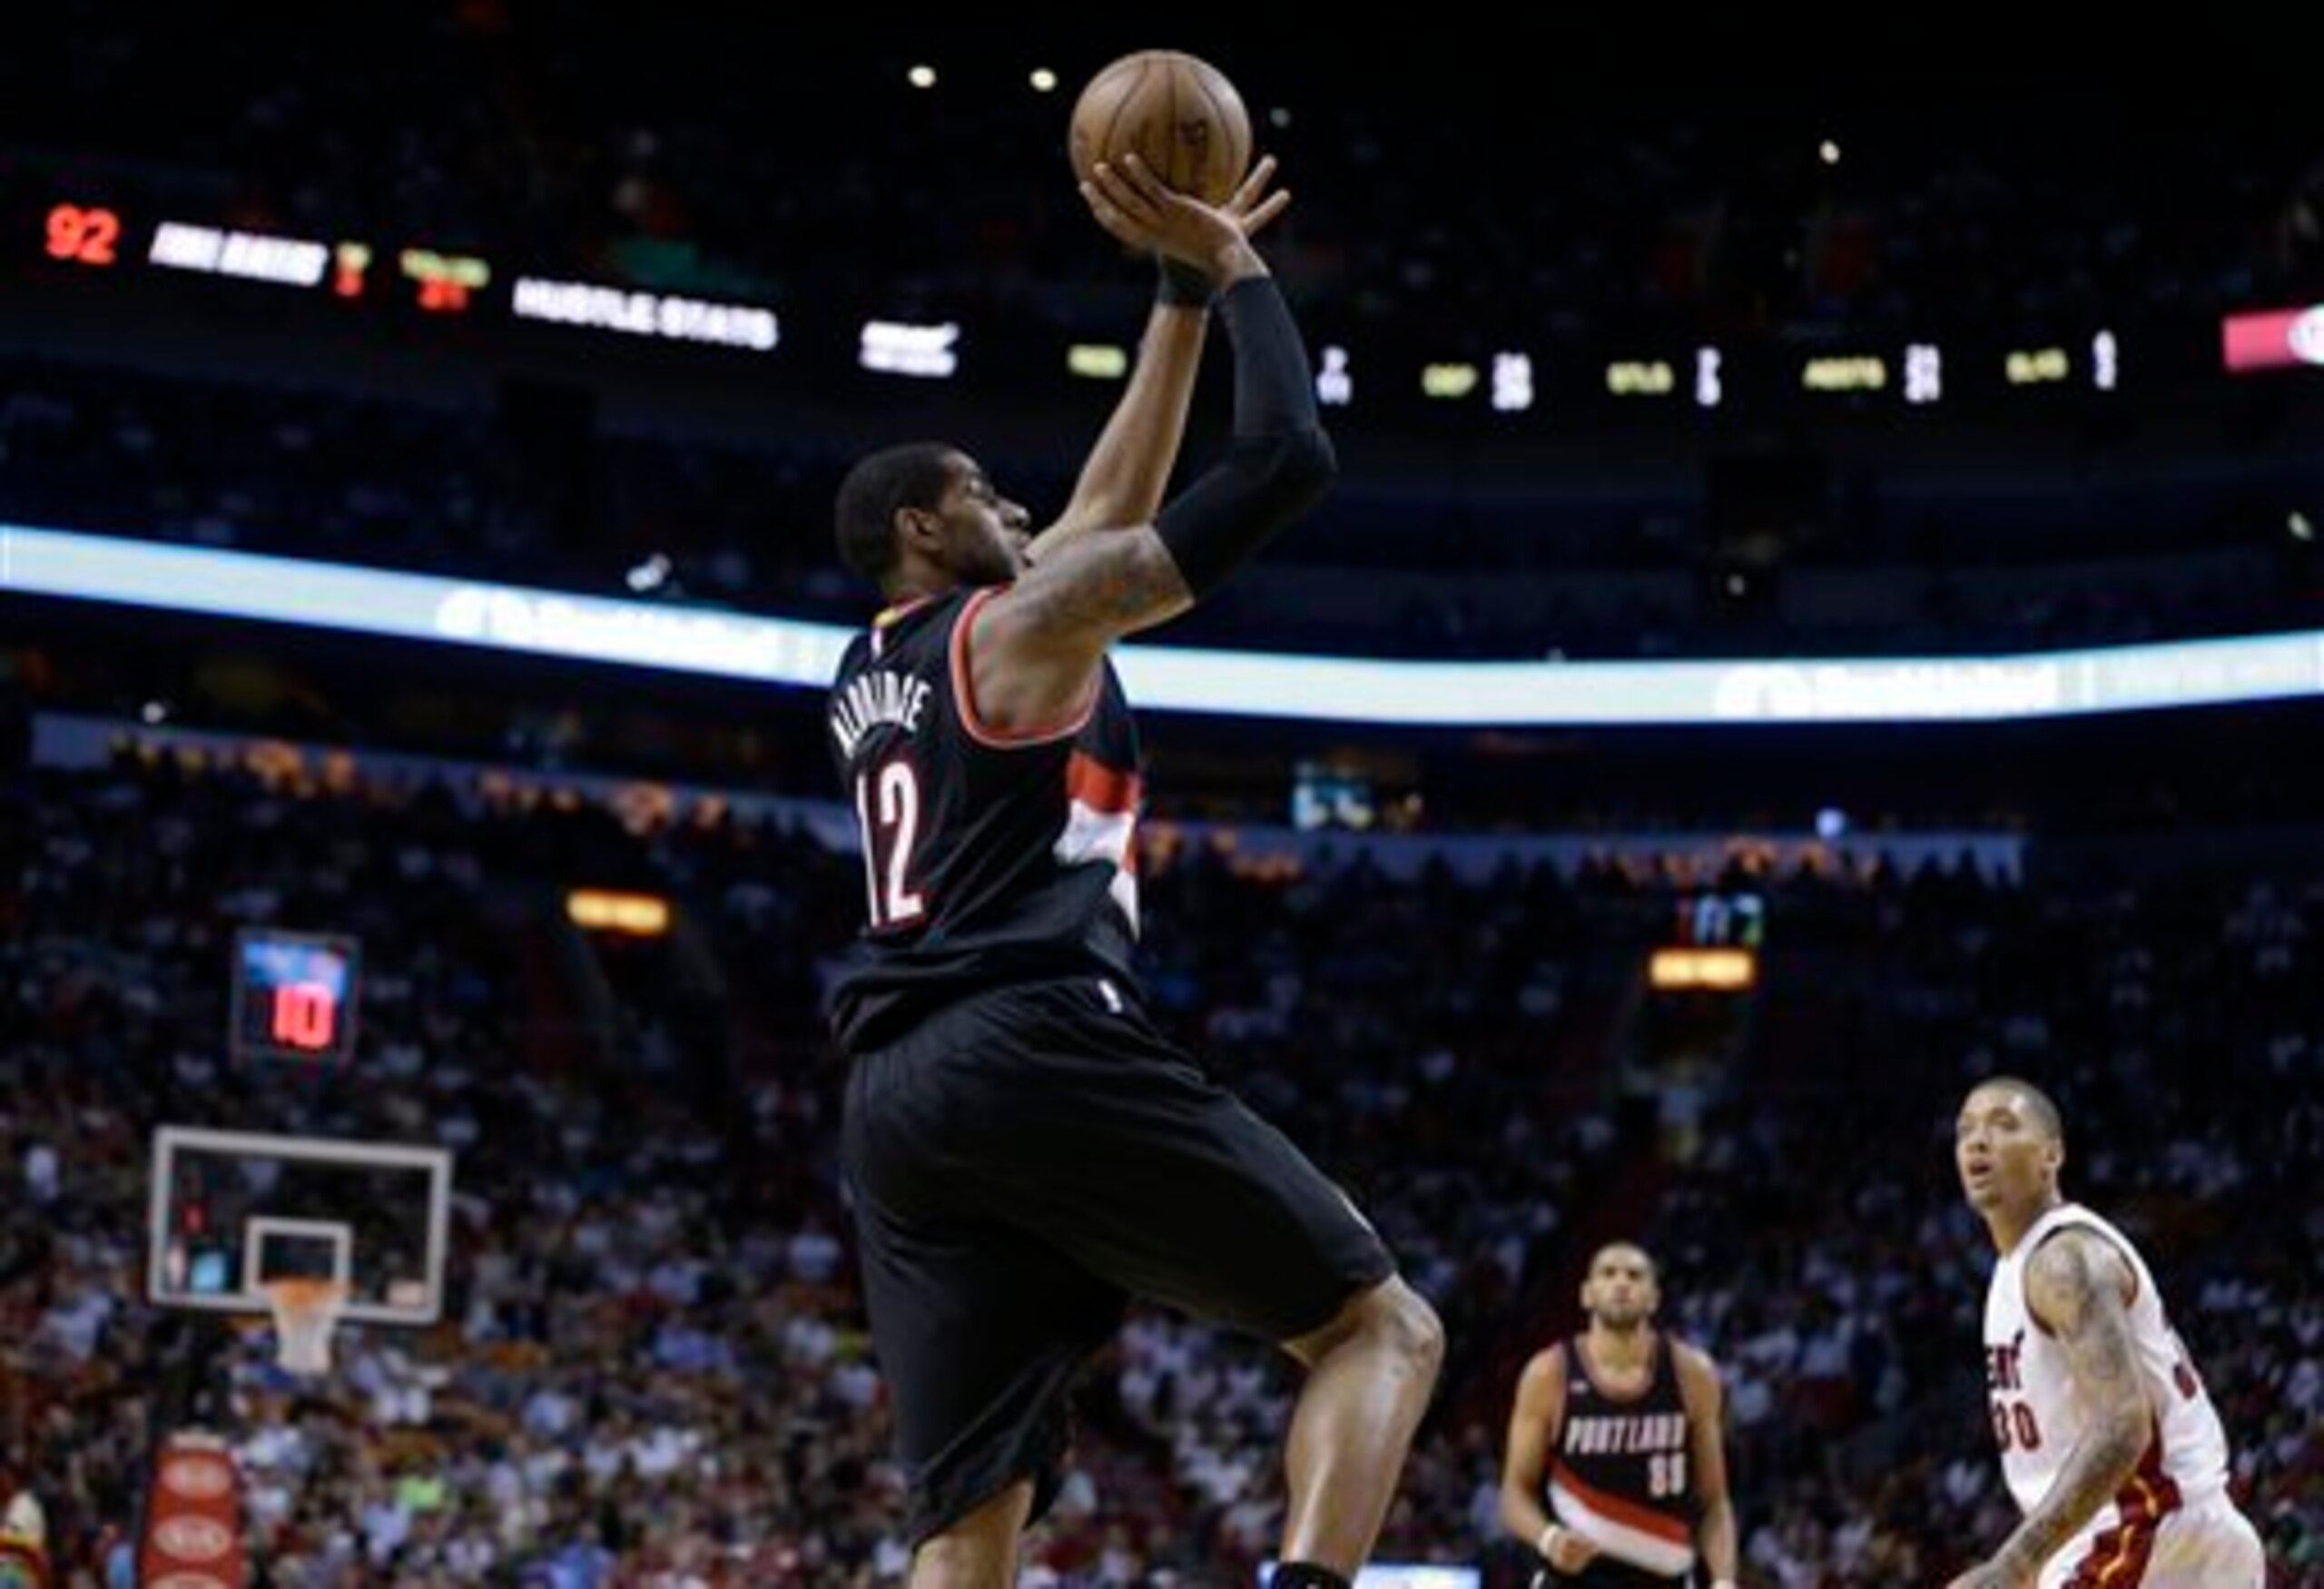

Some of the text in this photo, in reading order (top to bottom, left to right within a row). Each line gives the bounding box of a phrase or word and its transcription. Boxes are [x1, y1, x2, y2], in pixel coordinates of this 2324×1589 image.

[46, 202, 118, 264] 92
[856, 761, 922, 928] 12
[274, 982, 333, 1049] 10
[1563, 1413, 1686, 1454] PORTLAND
